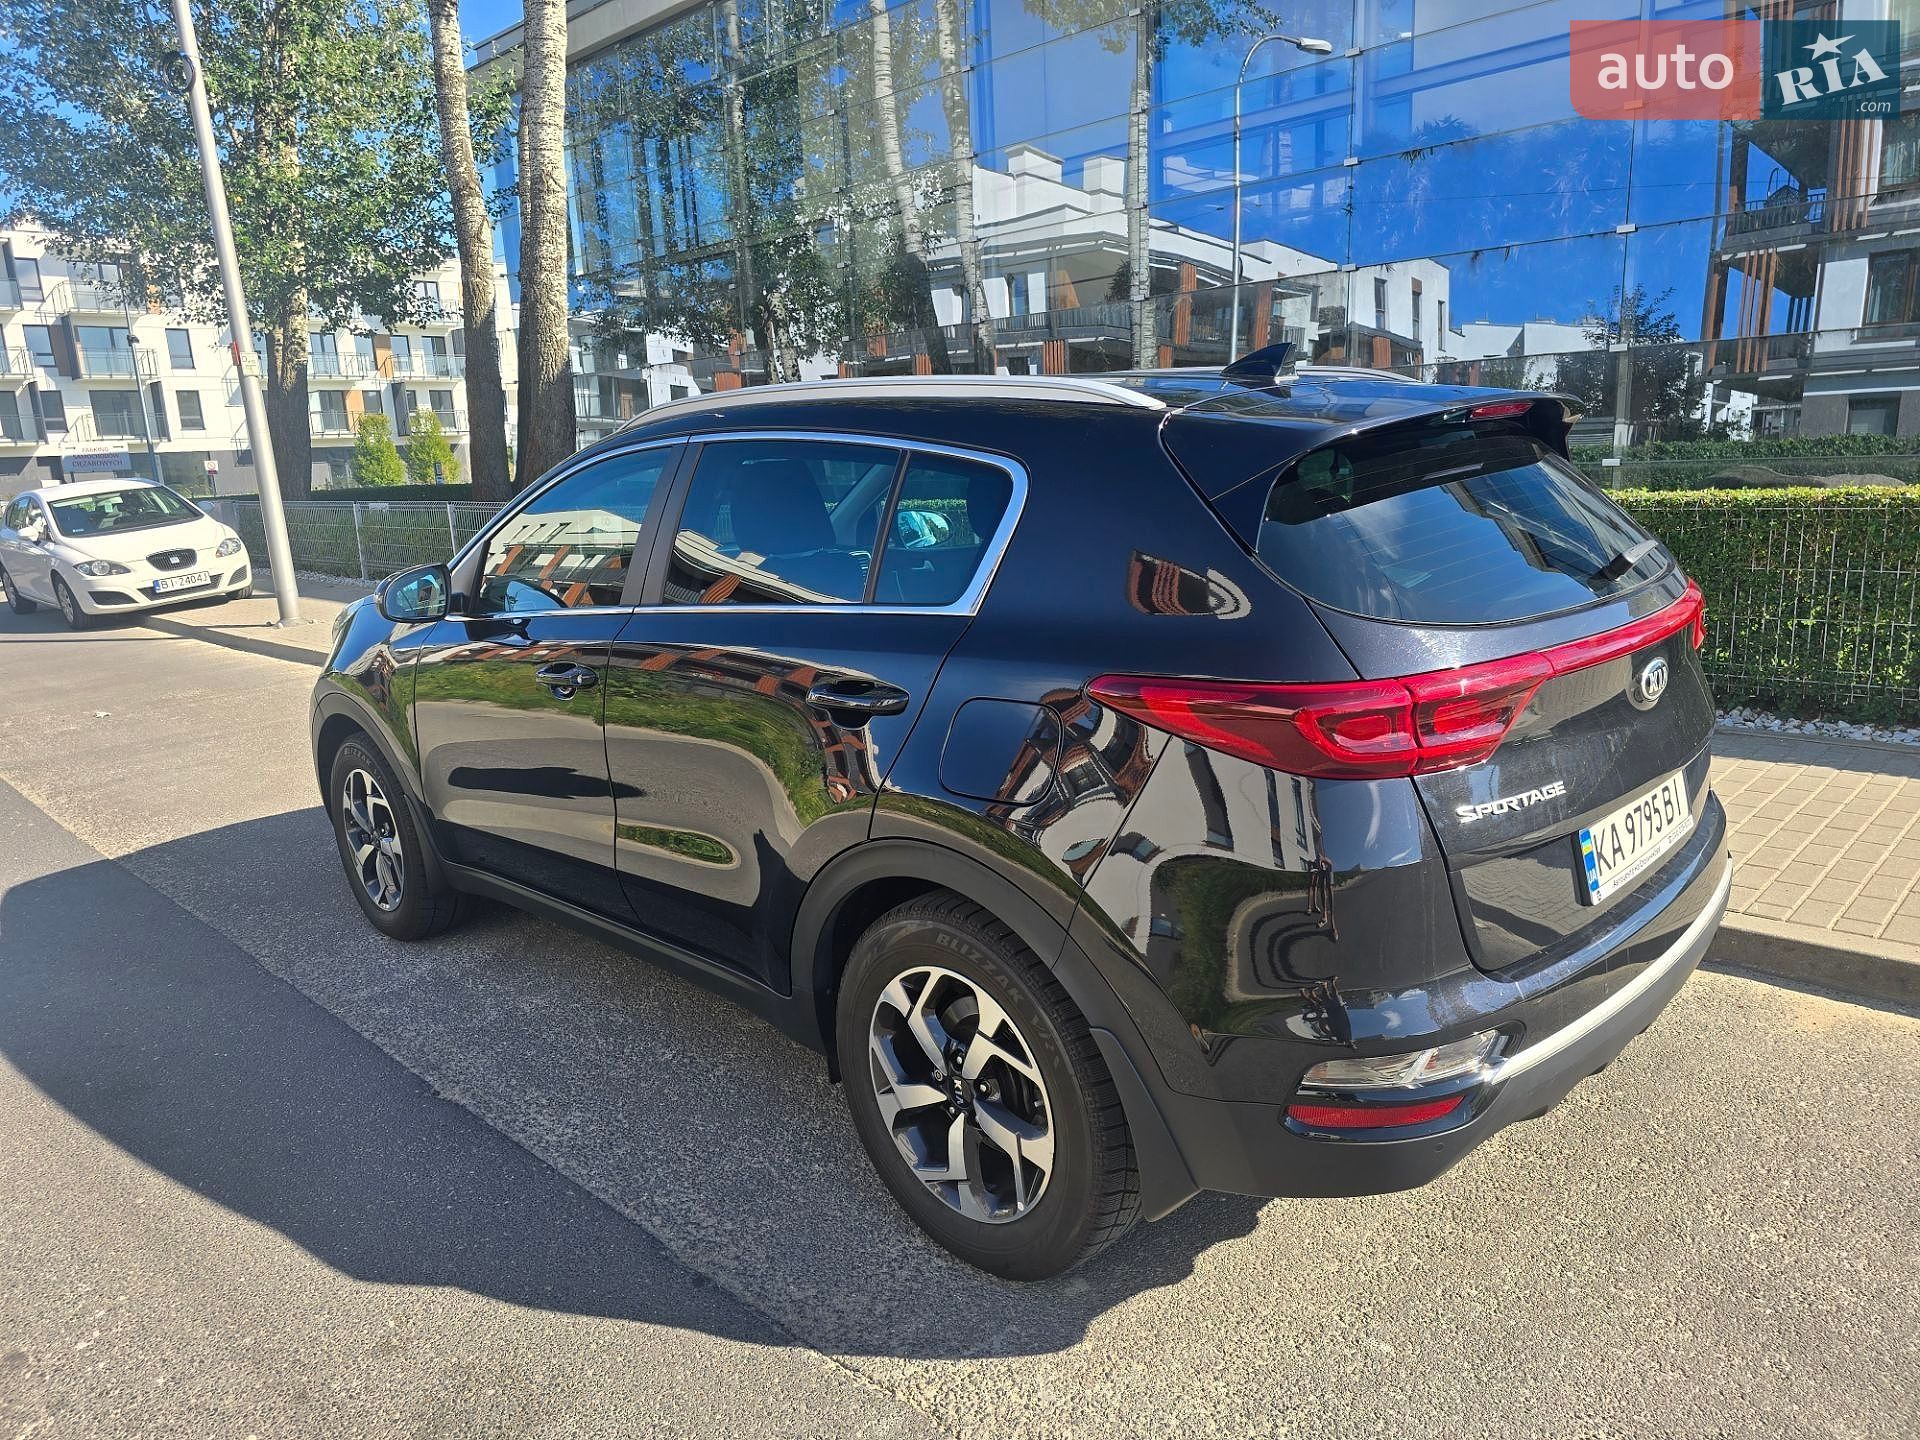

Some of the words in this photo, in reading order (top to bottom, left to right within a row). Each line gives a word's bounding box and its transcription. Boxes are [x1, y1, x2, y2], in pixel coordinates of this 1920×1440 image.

[161, 579, 174, 589] BI
[1455, 781, 1567, 823] SPORTAGE
[1593, 822, 1625, 877] KA
[1625, 793, 1663, 856] 9795
[1662, 778, 1682, 826] BI
[936, 933, 1022, 1004] BLIZZAK
[953, 1079, 964, 1105] KIA
